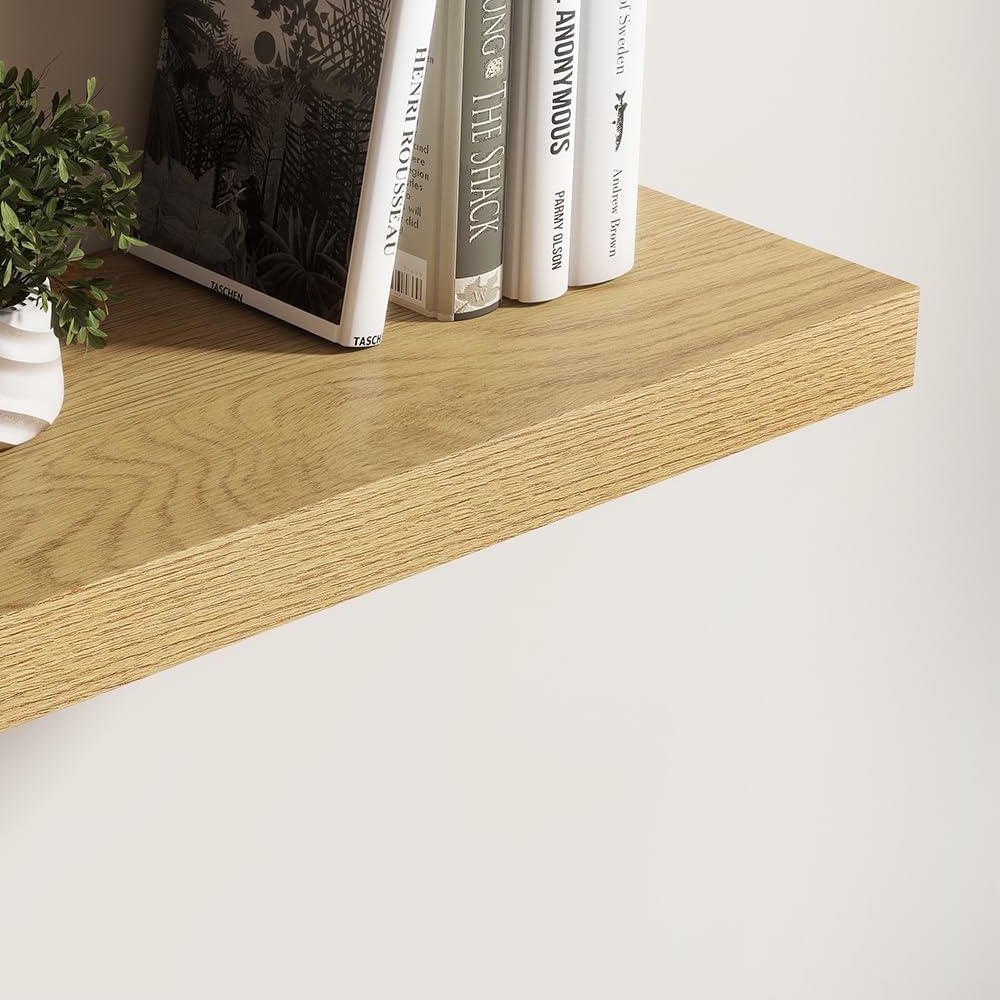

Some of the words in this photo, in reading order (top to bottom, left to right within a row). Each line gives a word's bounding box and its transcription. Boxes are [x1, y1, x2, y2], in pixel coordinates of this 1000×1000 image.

[616, 14, 631, 75] Sweden
[405, 48, 427, 121] HENRI
[472, 80, 507, 143] THE
[549, 10, 576, 155] ANONYMOUS
[383, 131, 414, 255] ROUSSEAU
[469, 146, 505, 243] SHACK
[553, 190, 566, 230] PARMY
[611, 168, 623, 214] Andrew
[551, 233, 564, 271] OLSON
[609, 220, 621, 258] Brown
[210, 281, 243, 302] TASCHEN
